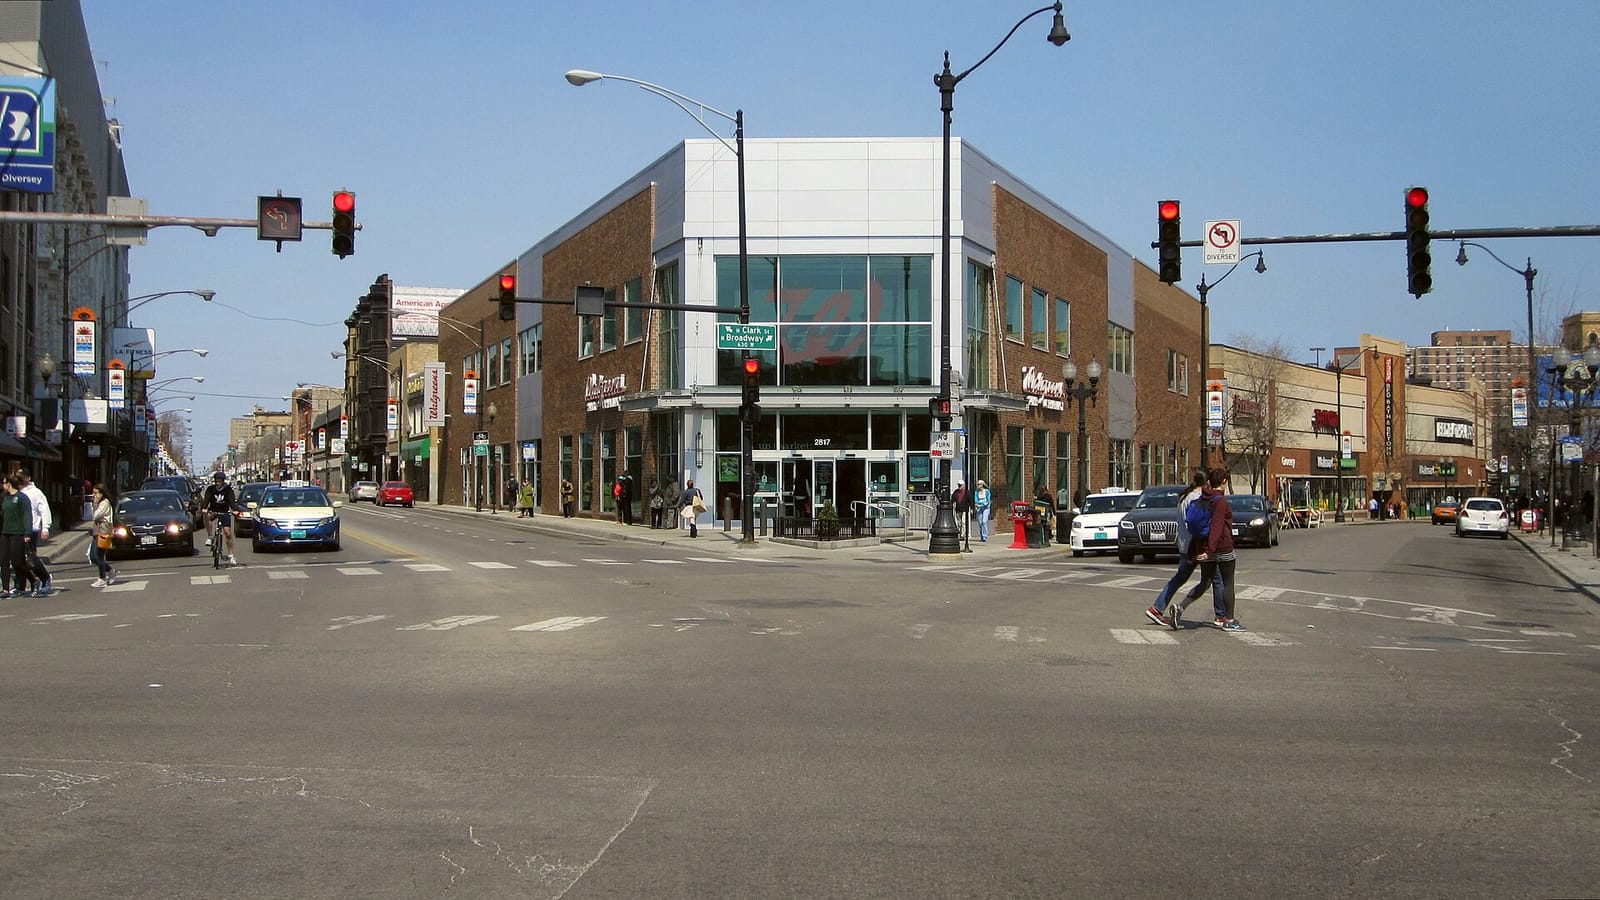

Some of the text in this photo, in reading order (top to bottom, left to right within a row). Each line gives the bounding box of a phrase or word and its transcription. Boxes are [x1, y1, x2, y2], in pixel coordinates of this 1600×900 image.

[2, 174, 42, 184] Diversey
[396, 299, 433, 308] American
[742, 326, 761, 335] Clark
[726, 333, 764, 344] Broadway
[429, 368, 441, 420] Walgreens
[937, 432, 948, 440] NO
[814, 438, 831, 446] 2817
